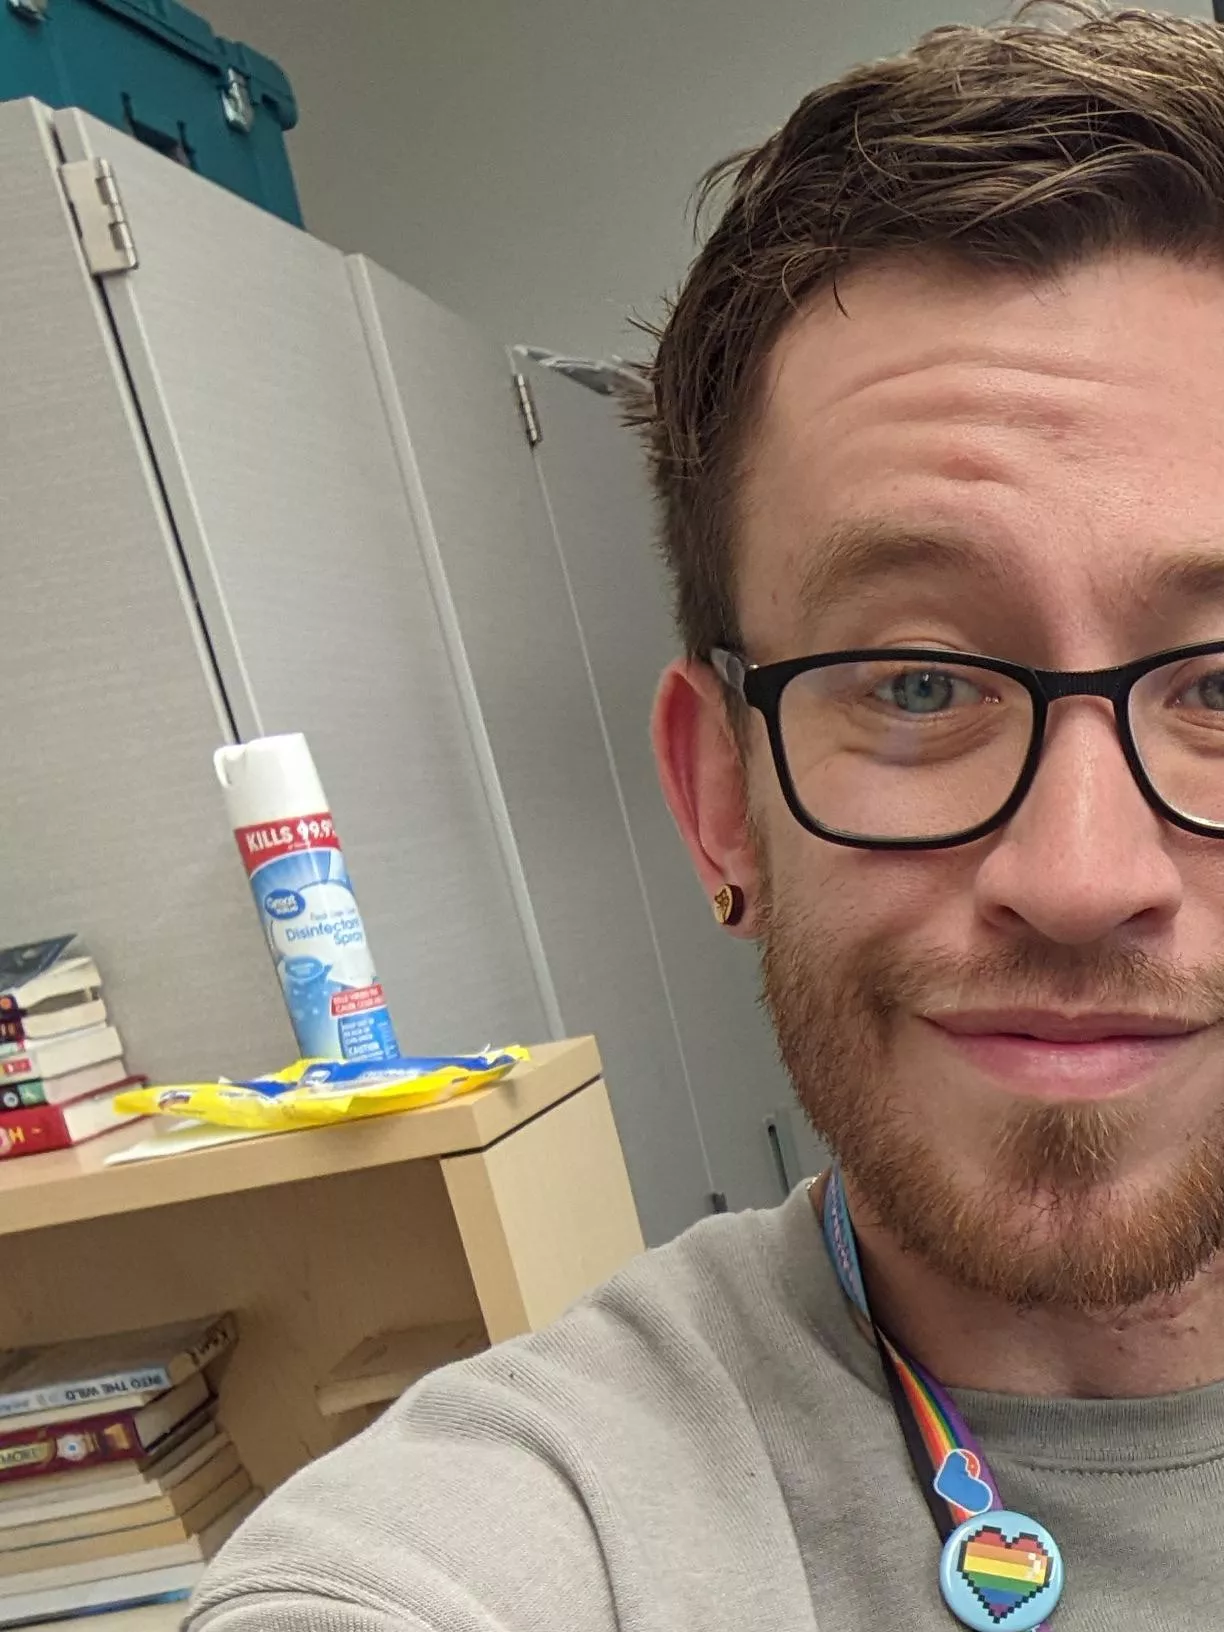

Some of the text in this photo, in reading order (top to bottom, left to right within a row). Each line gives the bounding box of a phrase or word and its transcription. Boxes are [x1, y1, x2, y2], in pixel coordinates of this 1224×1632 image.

[245, 826, 293, 852] KILLS
[65, 1374, 162, 1401] INTO THE WILD
